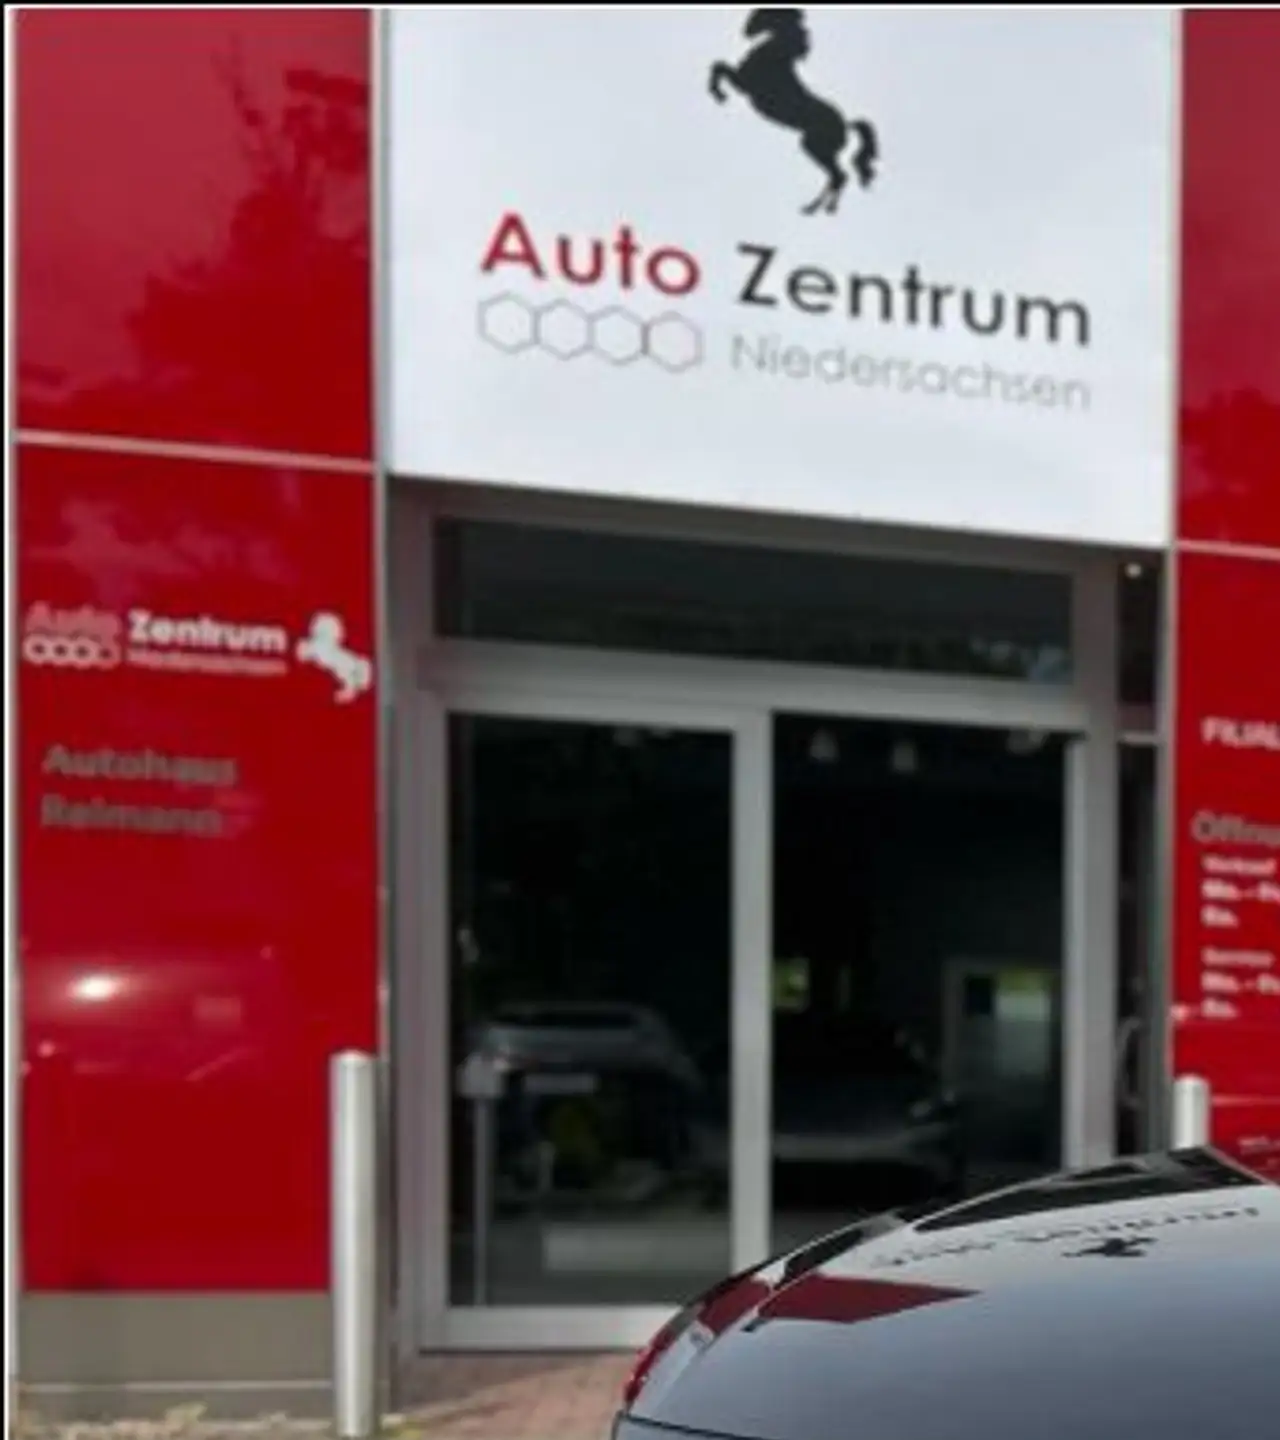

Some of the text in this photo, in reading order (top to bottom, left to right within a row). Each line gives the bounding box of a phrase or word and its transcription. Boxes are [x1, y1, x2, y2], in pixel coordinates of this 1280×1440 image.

[481, 212, 1091, 347] Auto Zentrum
[730, 334, 1091, 412] Niedersachsen
[127, 608, 288, 652] Zentrum
